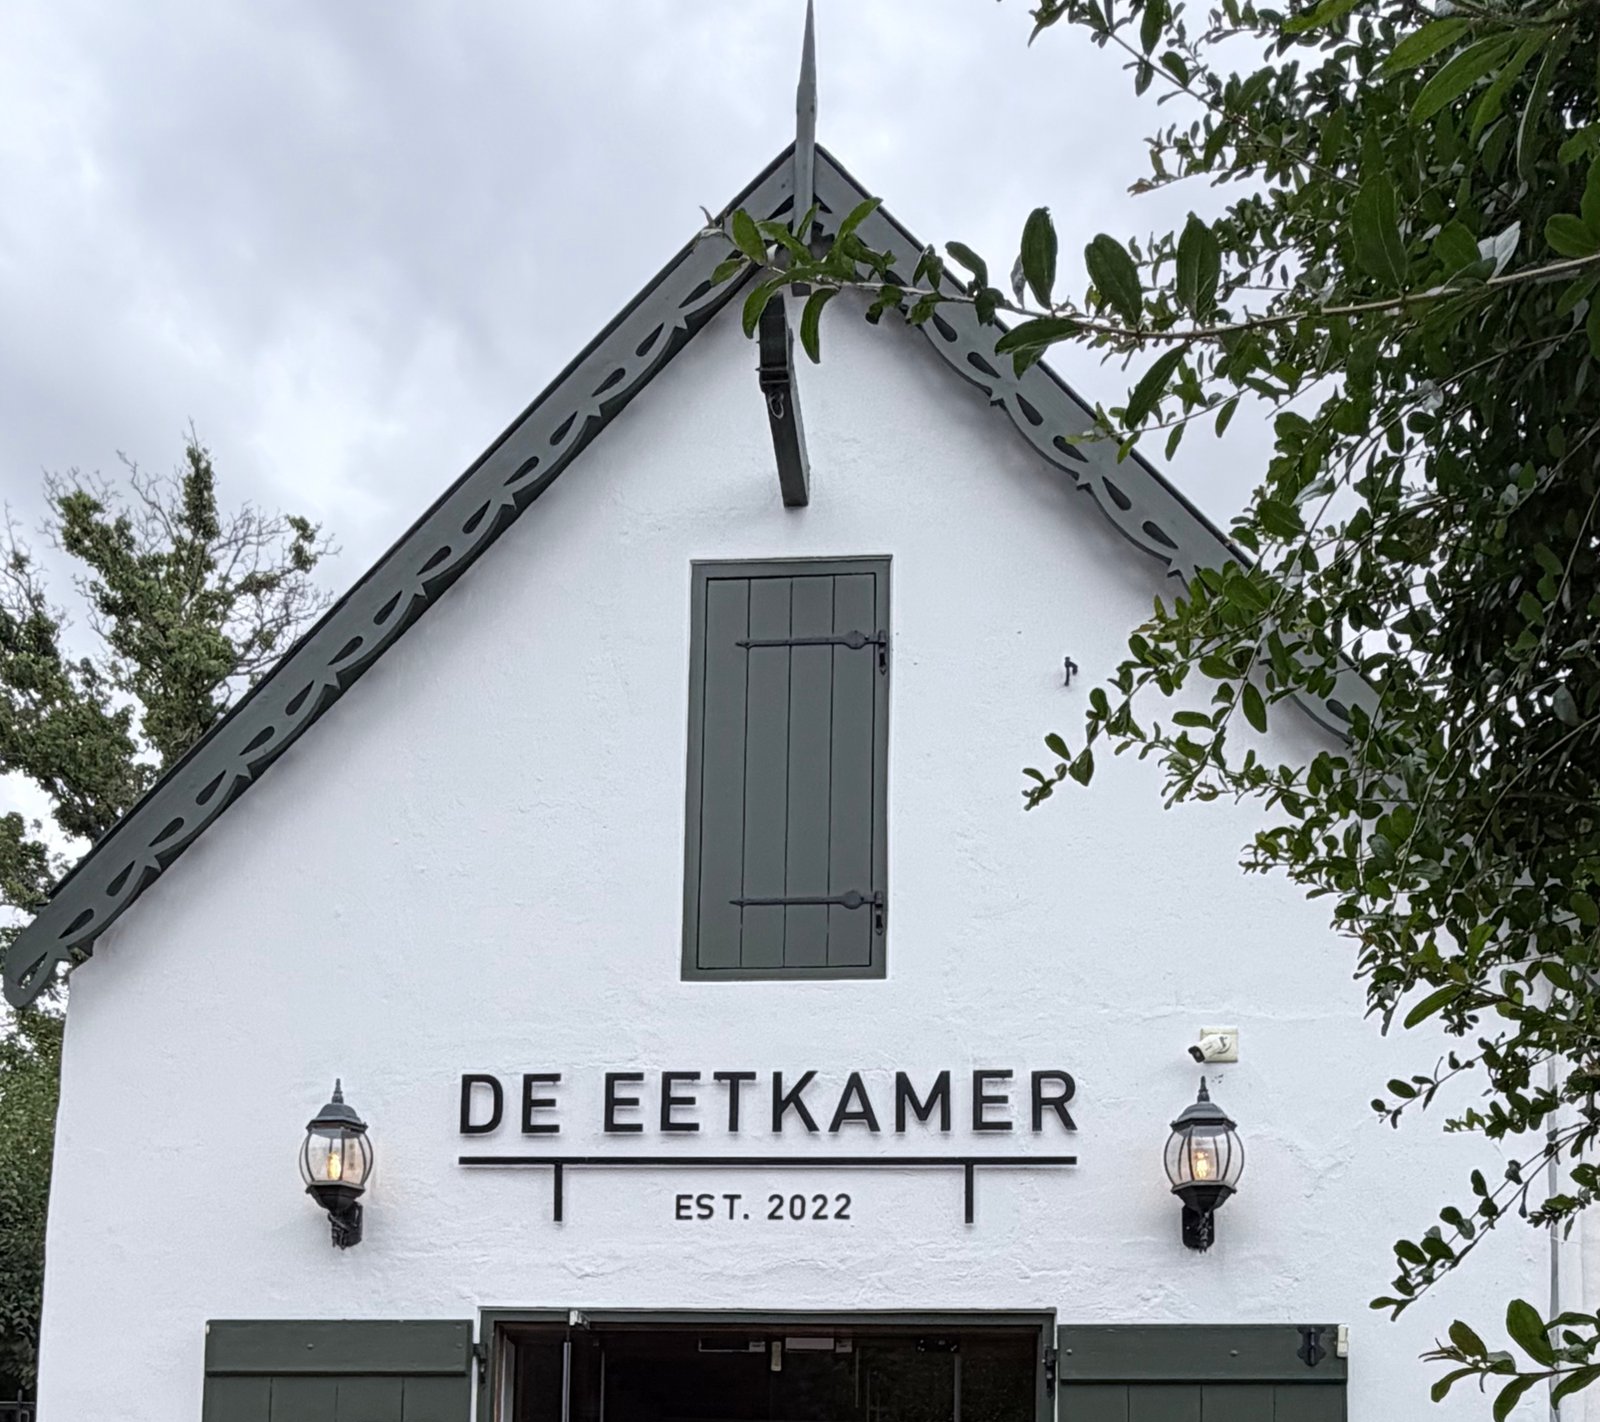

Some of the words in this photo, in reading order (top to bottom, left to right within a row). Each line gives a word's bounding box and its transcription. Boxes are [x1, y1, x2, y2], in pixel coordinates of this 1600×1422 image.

[459, 1073, 561, 1135] DE
[604, 1069, 1077, 1133] EETKAMER
[675, 1193, 749, 1220] EST.
[767, 1193, 851, 1221] 2022
